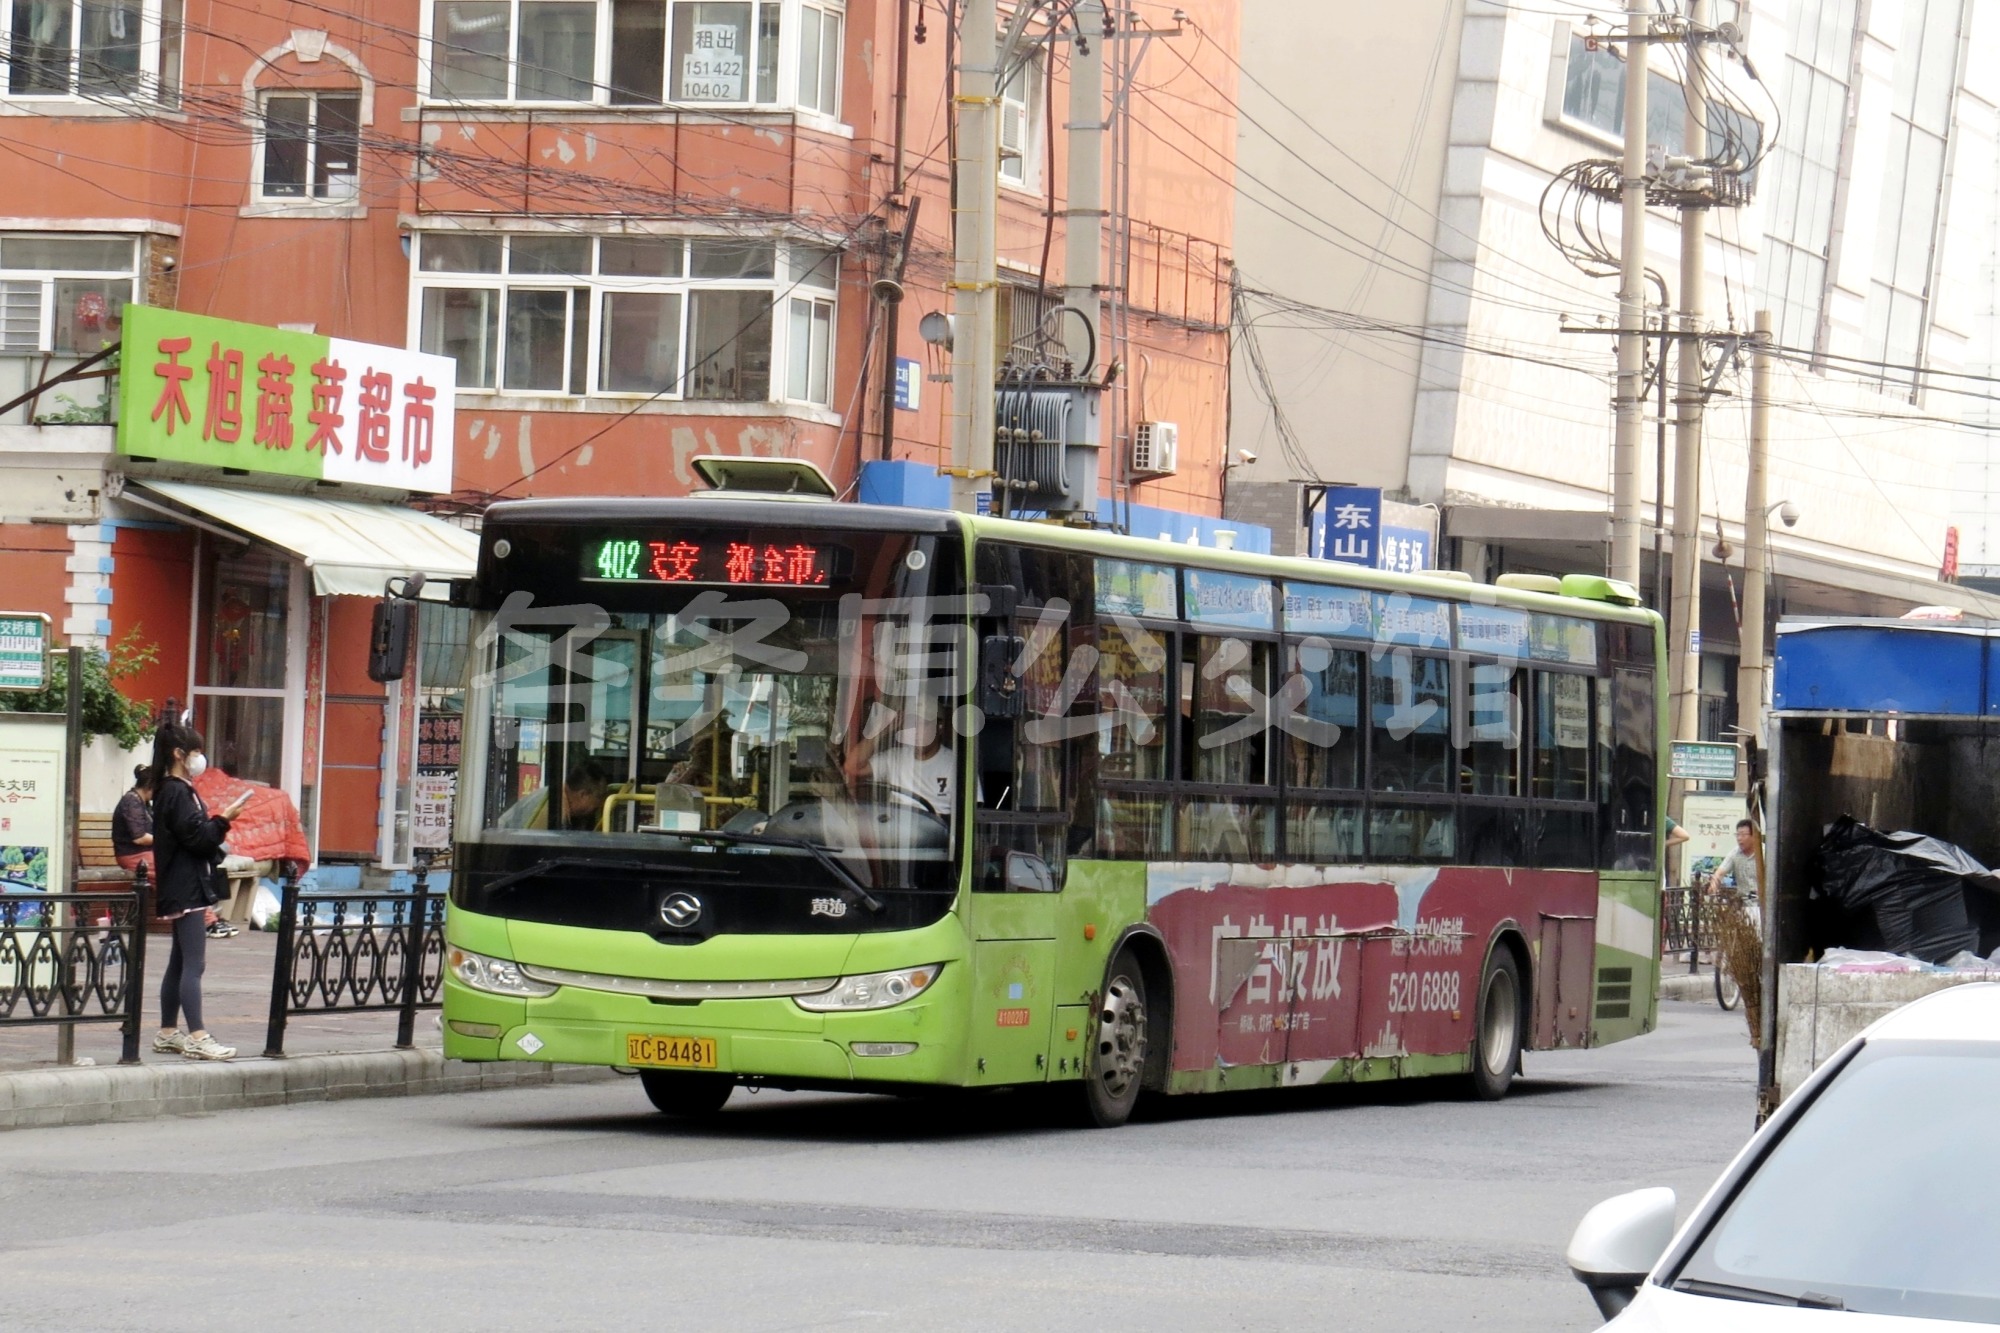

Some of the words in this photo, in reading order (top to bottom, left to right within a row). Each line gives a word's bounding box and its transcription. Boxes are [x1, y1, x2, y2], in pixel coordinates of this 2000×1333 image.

[695, 30, 734, 50] 租出
[151, 336, 437, 469] 禾旭蔬菜超市
[1333, 503, 1372, 568] 东山
[1380, 535, 1423, 572] 停车场
[598, 540, 641, 579] 402
[0, 620, 37, 636] 交桥南
[811, 898, 847, 917] 黄海
[1209, 914, 1345, 1006] 广告投放
[521, 1039, 540, 1049] LNG
